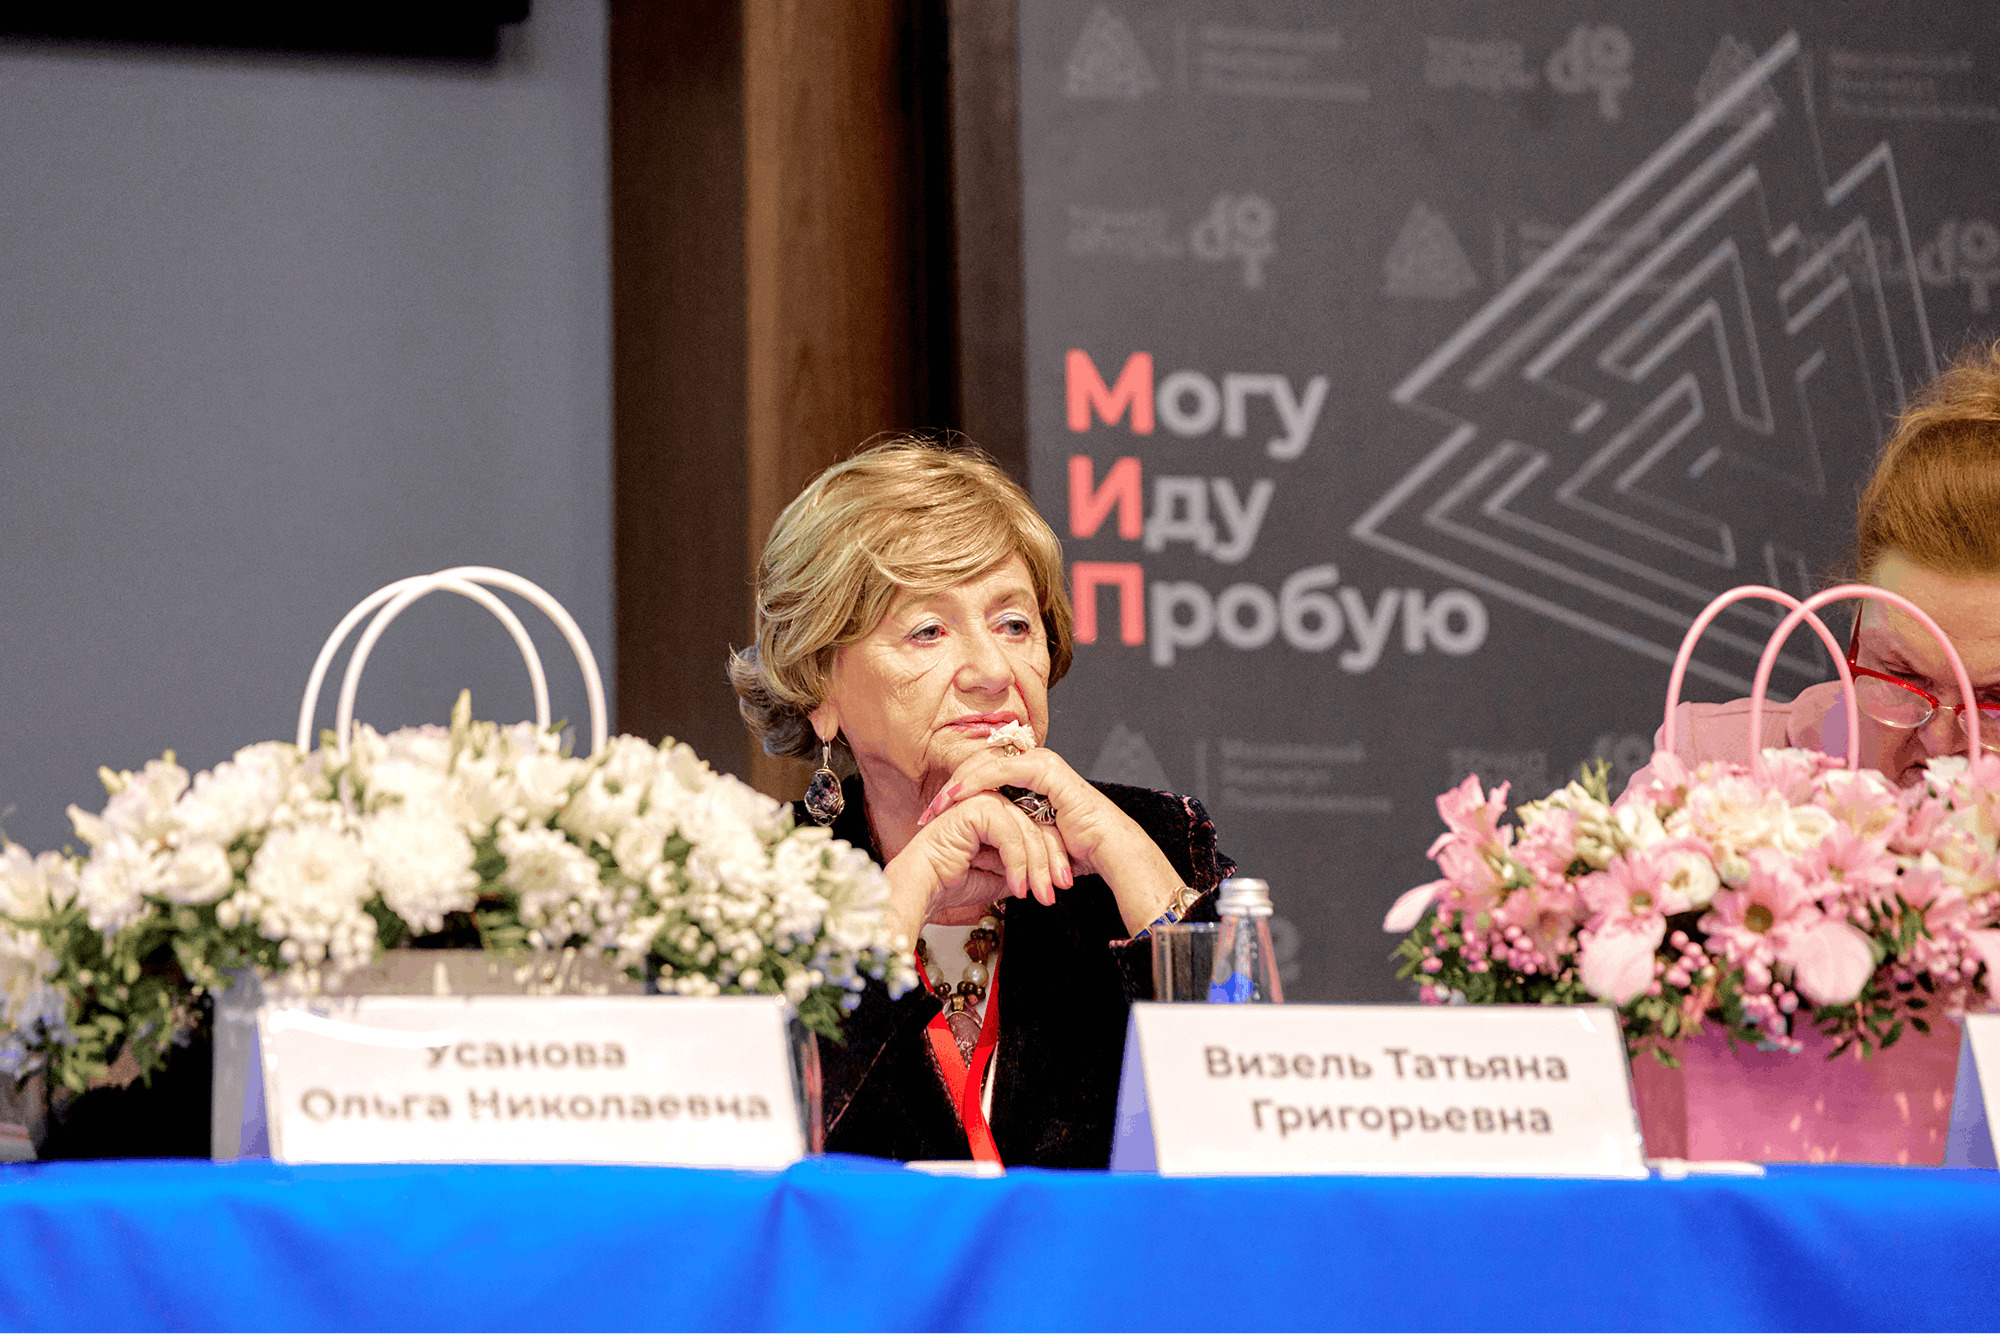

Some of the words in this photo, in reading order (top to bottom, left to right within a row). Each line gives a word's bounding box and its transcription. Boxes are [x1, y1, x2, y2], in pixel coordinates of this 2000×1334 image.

[1064, 348, 1330, 460] Могу
[1067, 454, 1275, 563] Иду
[1071, 560, 1489, 672] Пробую
[426, 1041, 627, 1069] Усанова
[1202, 1044, 1373, 1080] Визель
[1383, 1047, 1569, 1082] Татьяна
[299, 1087, 452, 1121] Ольга
[467, 1088, 771, 1121] Николаевна
[1250, 1098, 1553, 1140] Григорьевна
